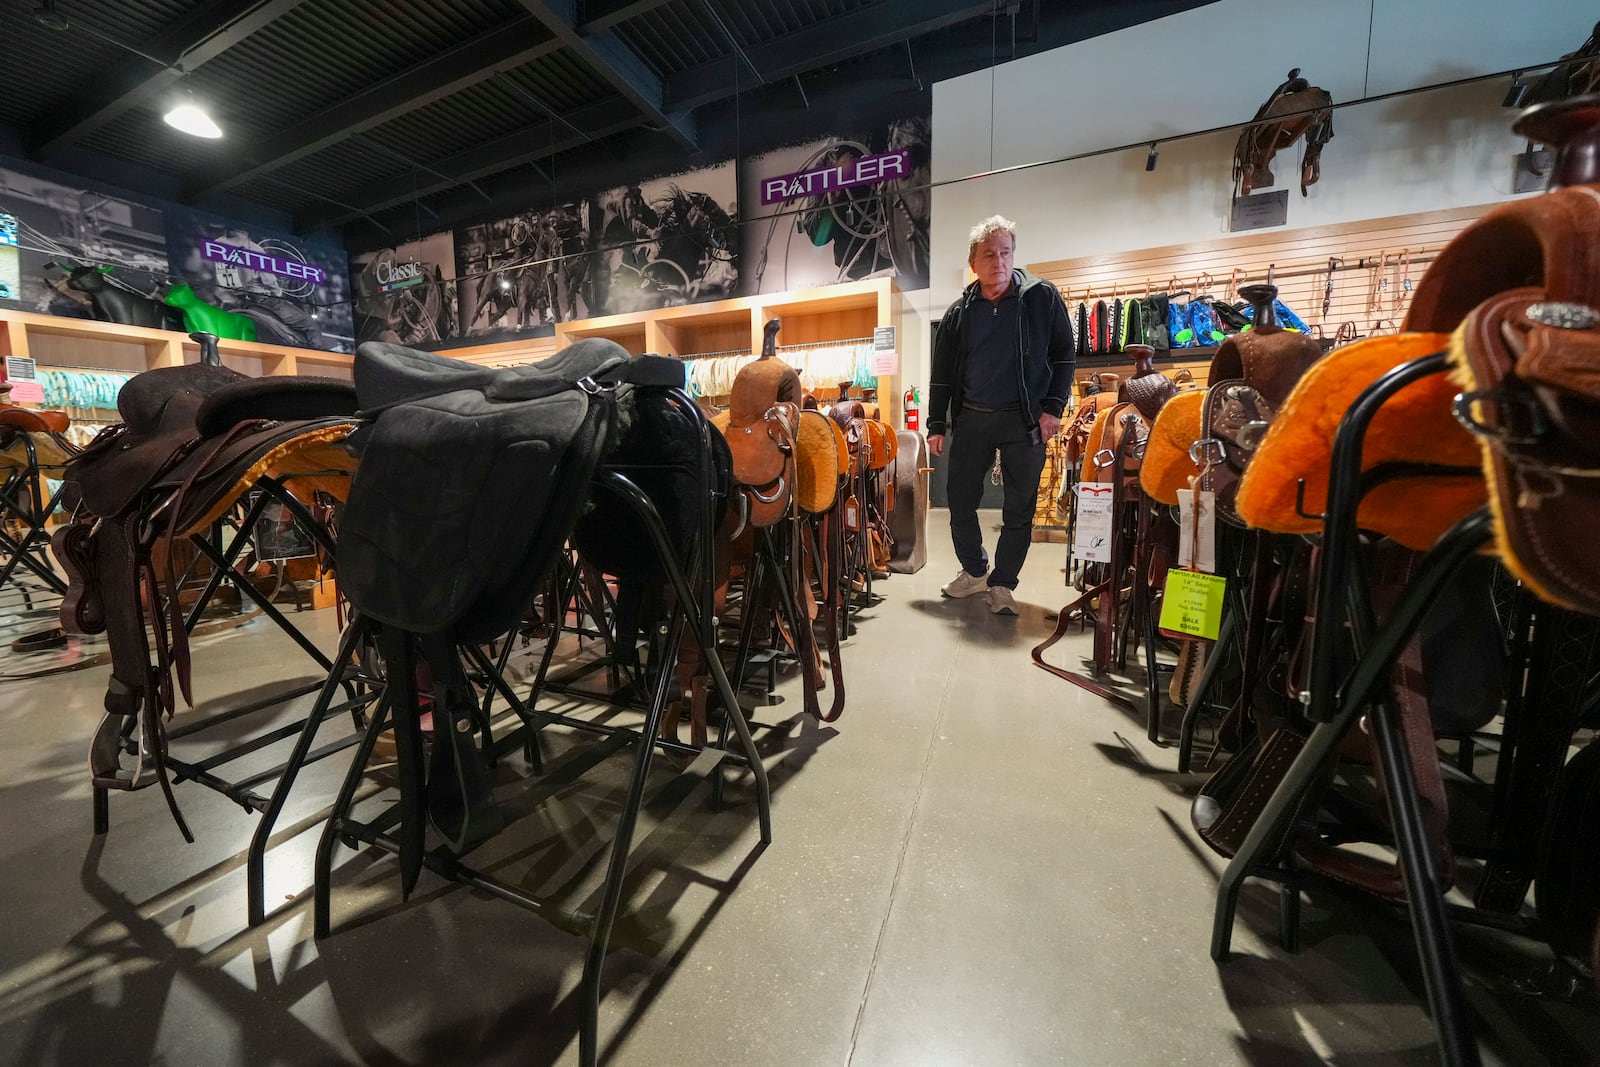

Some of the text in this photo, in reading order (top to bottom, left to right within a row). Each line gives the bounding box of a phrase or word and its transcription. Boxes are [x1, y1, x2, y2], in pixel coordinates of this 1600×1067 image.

[766, 153, 904, 202] RATTLER
[204, 241, 321, 283] RATTLER
[376, 255, 422, 285] Classic
[1168, 569, 1190, 578] Martin
[1182, 616, 1199, 624] SALE
